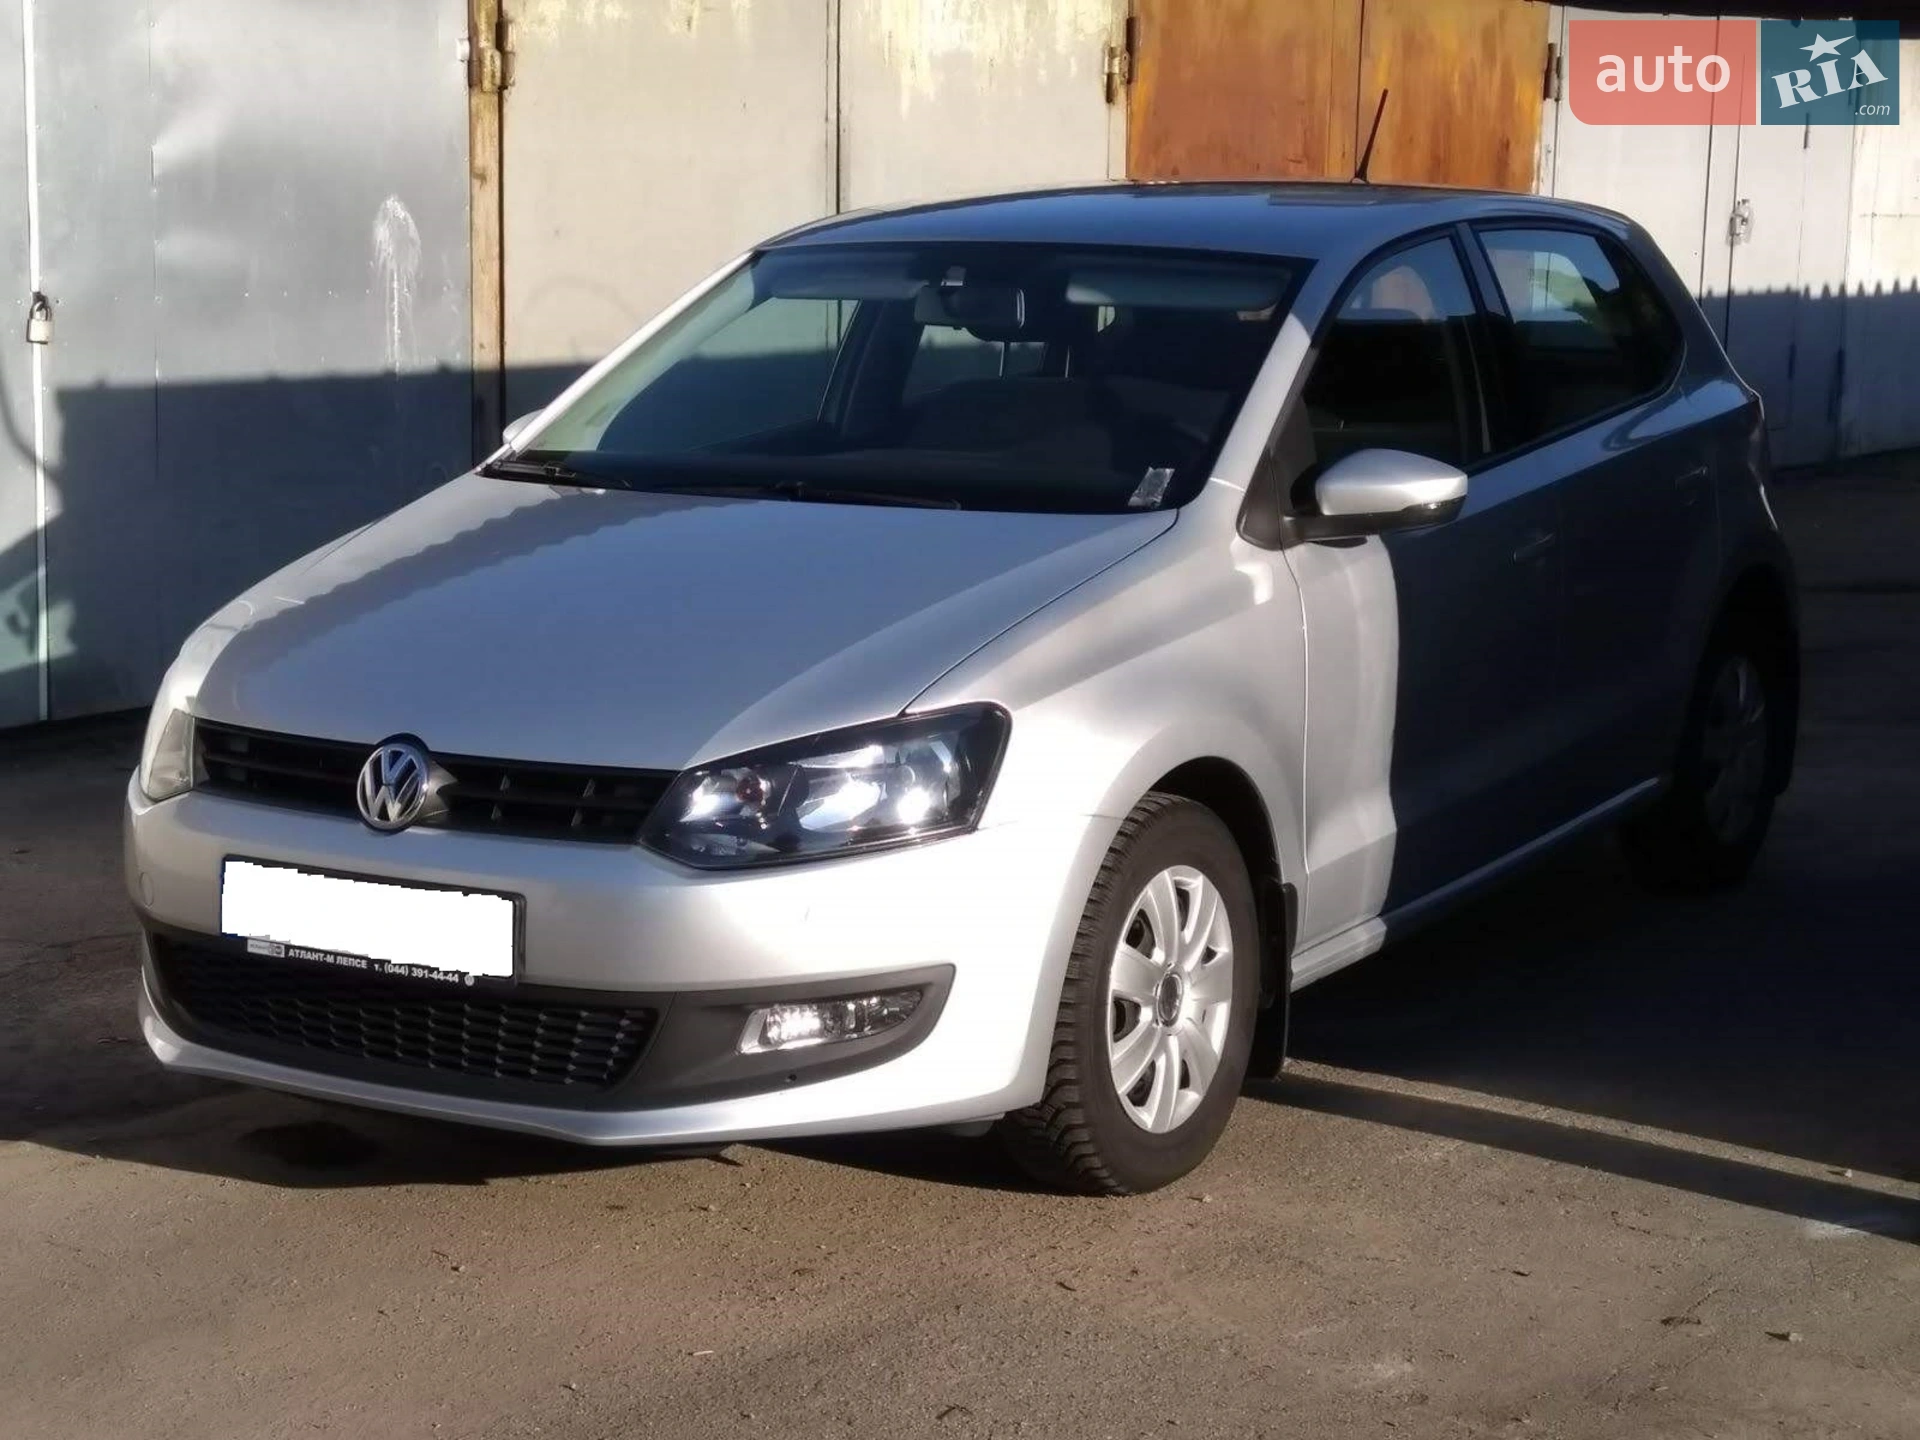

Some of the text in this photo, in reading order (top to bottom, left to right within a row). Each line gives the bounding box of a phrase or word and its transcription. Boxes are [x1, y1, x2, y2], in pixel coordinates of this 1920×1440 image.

[288, 948, 335, 963] АТЛАНТ-М
[336, 955, 368, 969] ЛЕПСЕ
[384, 962, 409, 976] (044)
[411, 967, 459, 983] 391-44-44
